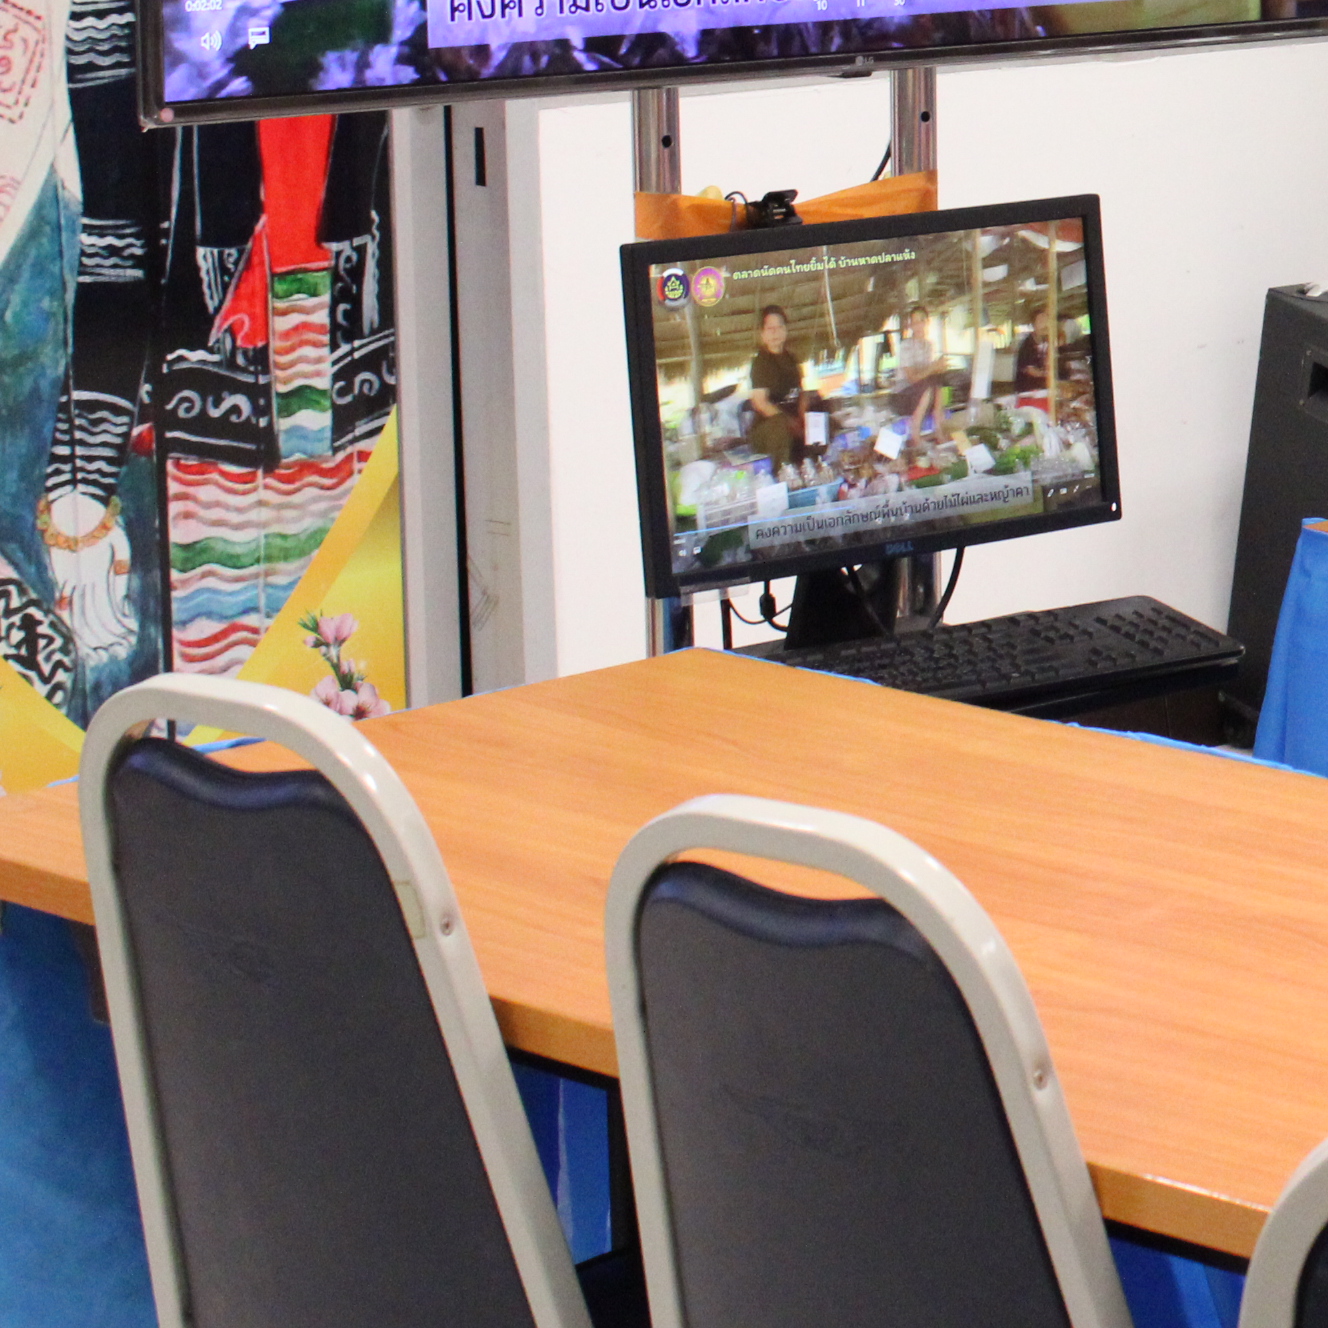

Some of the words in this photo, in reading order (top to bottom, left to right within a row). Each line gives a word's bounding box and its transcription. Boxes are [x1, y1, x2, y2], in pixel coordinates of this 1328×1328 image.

[732, 255, 836, 281] ตลาดนัดคนไทยยิ้มได้
